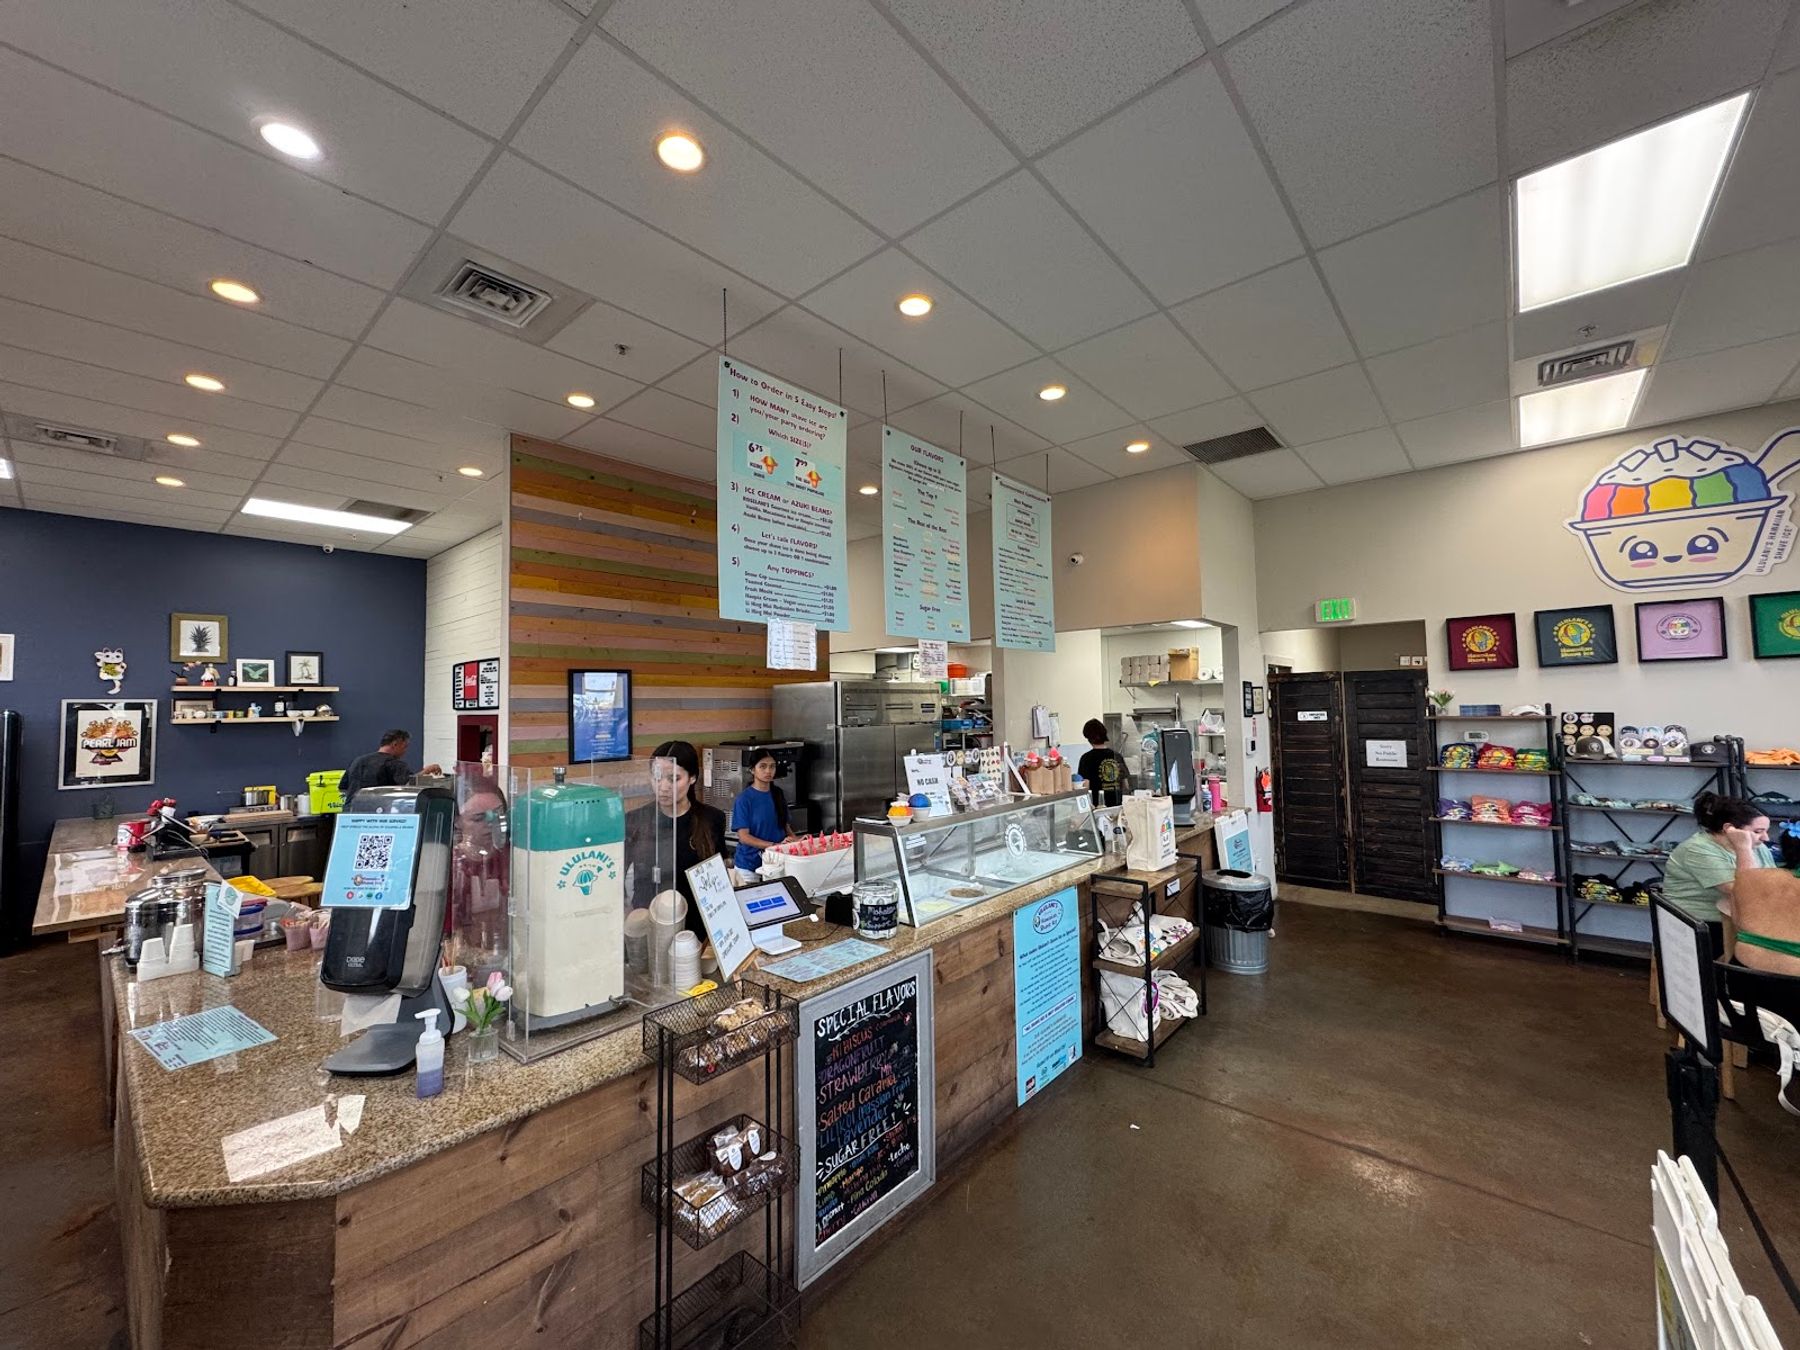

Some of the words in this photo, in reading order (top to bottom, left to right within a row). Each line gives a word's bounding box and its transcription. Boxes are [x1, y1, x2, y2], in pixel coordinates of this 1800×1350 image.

[730, 368, 748, 382] How
[751, 378, 758, 386] to
[761, 382, 784, 396] Order
[786, 392, 793, 400] in
[801, 398, 816, 412] Easy
[732, 388, 740, 399] 1)
[750, 394, 768, 406] HOW
[770, 402, 790, 415] MANY
[731, 413, 740, 424] 2)
[780, 418, 797, 430] party
[768, 428, 788, 441] Which
[730, 482, 738, 492] 3)
[745, 486, 755, 495] ICE
[758, 490, 780, 502] CREAM
[791, 500, 810, 510] AZUKI
[731, 524, 740, 534] 4)
[762, 531, 776, 540] Let's
[1755, 541, 1774, 572] ULULANI'S
[1768, 510, 1785, 540] HAWAIIAN
[1774, 540, 1788, 559] SHAVE
[731, 557, 740, 567] 5)
[767, 564, 779, 574] Any
[1322, 598, 1349, 621] EXIT
[83, 739, 113, 748] PEARL
[116, 738, 136, 747] JAM
[560, 850, 615, 876] ULULANI'S
[817, 1001, 870, 1037] SPECIAL
[873, 980, 916, 1012] FLAVORS
[832, 1026, 873, 1060] HIBISCUS
[820, 1036, 885, 1082] DRAGONFRUIT
[819, 1051, 888, 1104] STRAWBERRY
[818, 1093, 856, 1132] Salted
[838, 1104, 888, 1148] Lavender
[825, 1142, 860, 1173] SUGAR
[860, 1112, 896, 1148] FREE!
